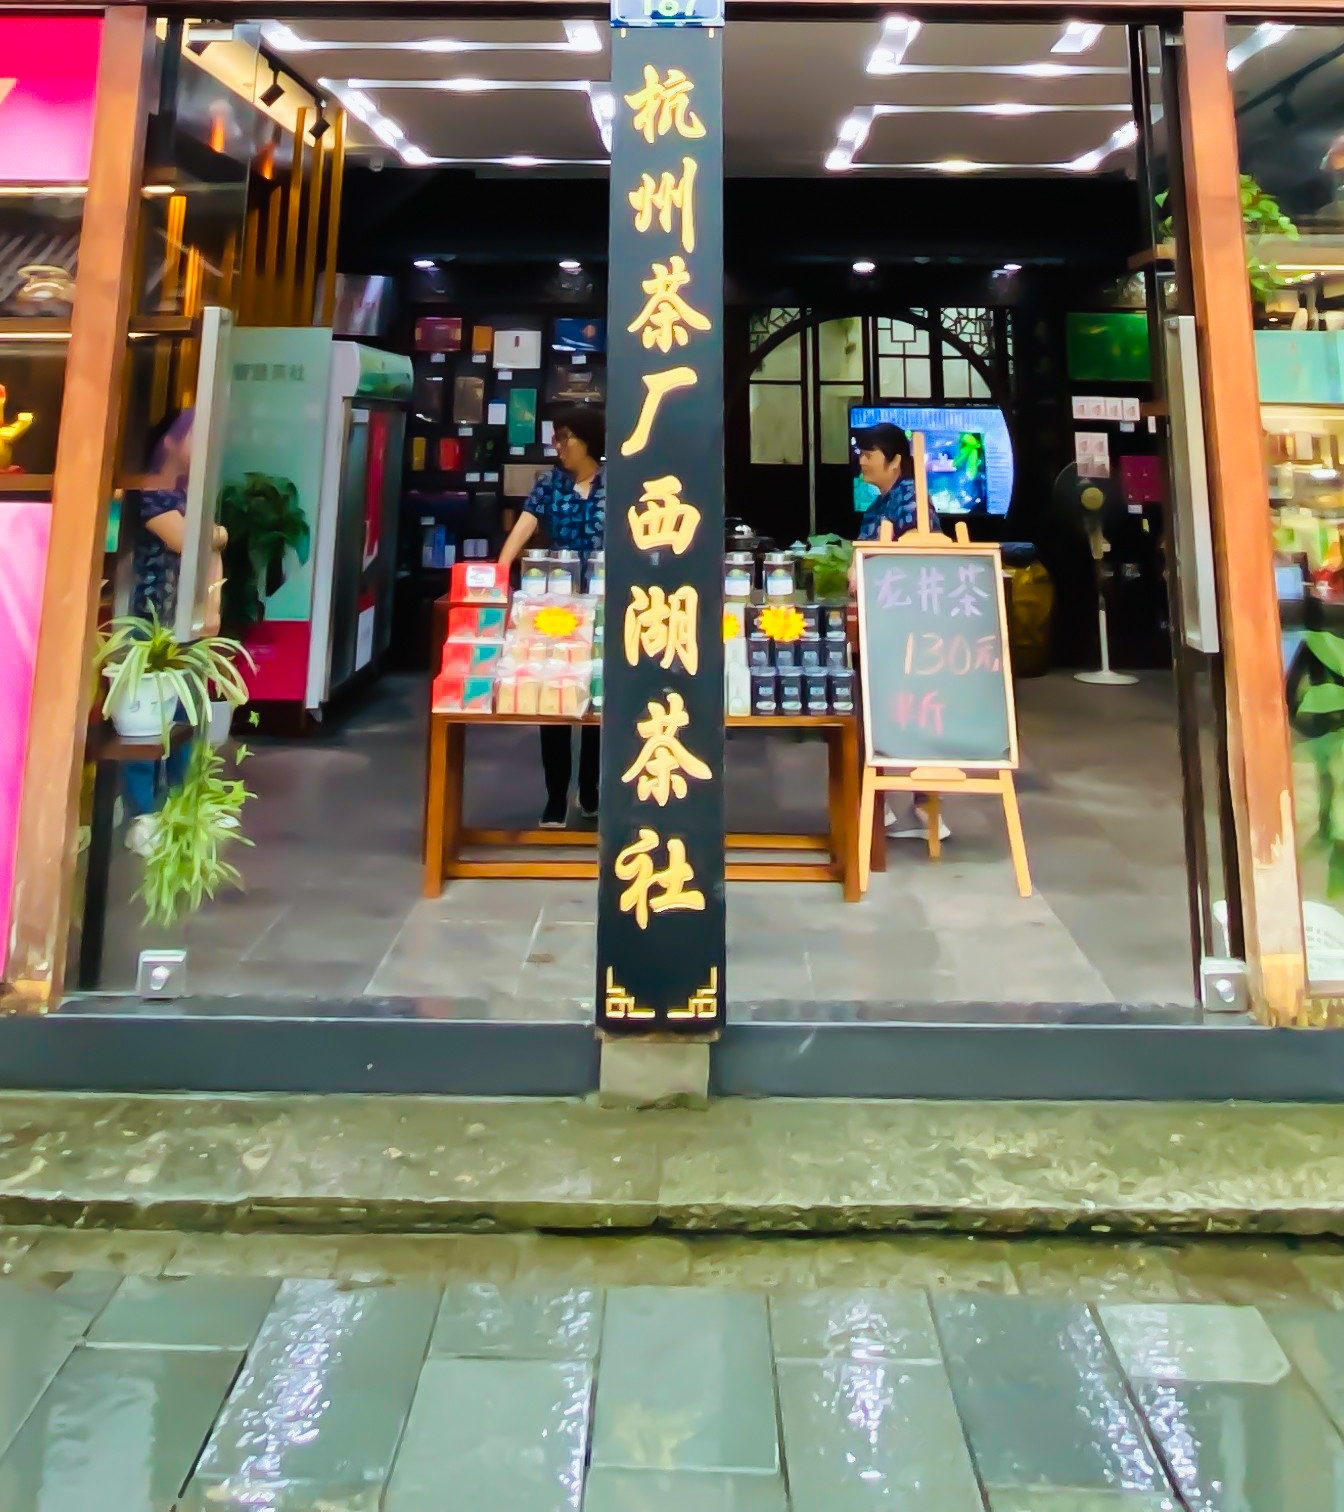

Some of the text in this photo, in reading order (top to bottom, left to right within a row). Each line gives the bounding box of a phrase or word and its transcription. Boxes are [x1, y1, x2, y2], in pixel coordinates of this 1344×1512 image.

[613, 63, 713, 931] 杭州茶厂西湖茶社
[874, 562, 991, 618] 龙井茶
